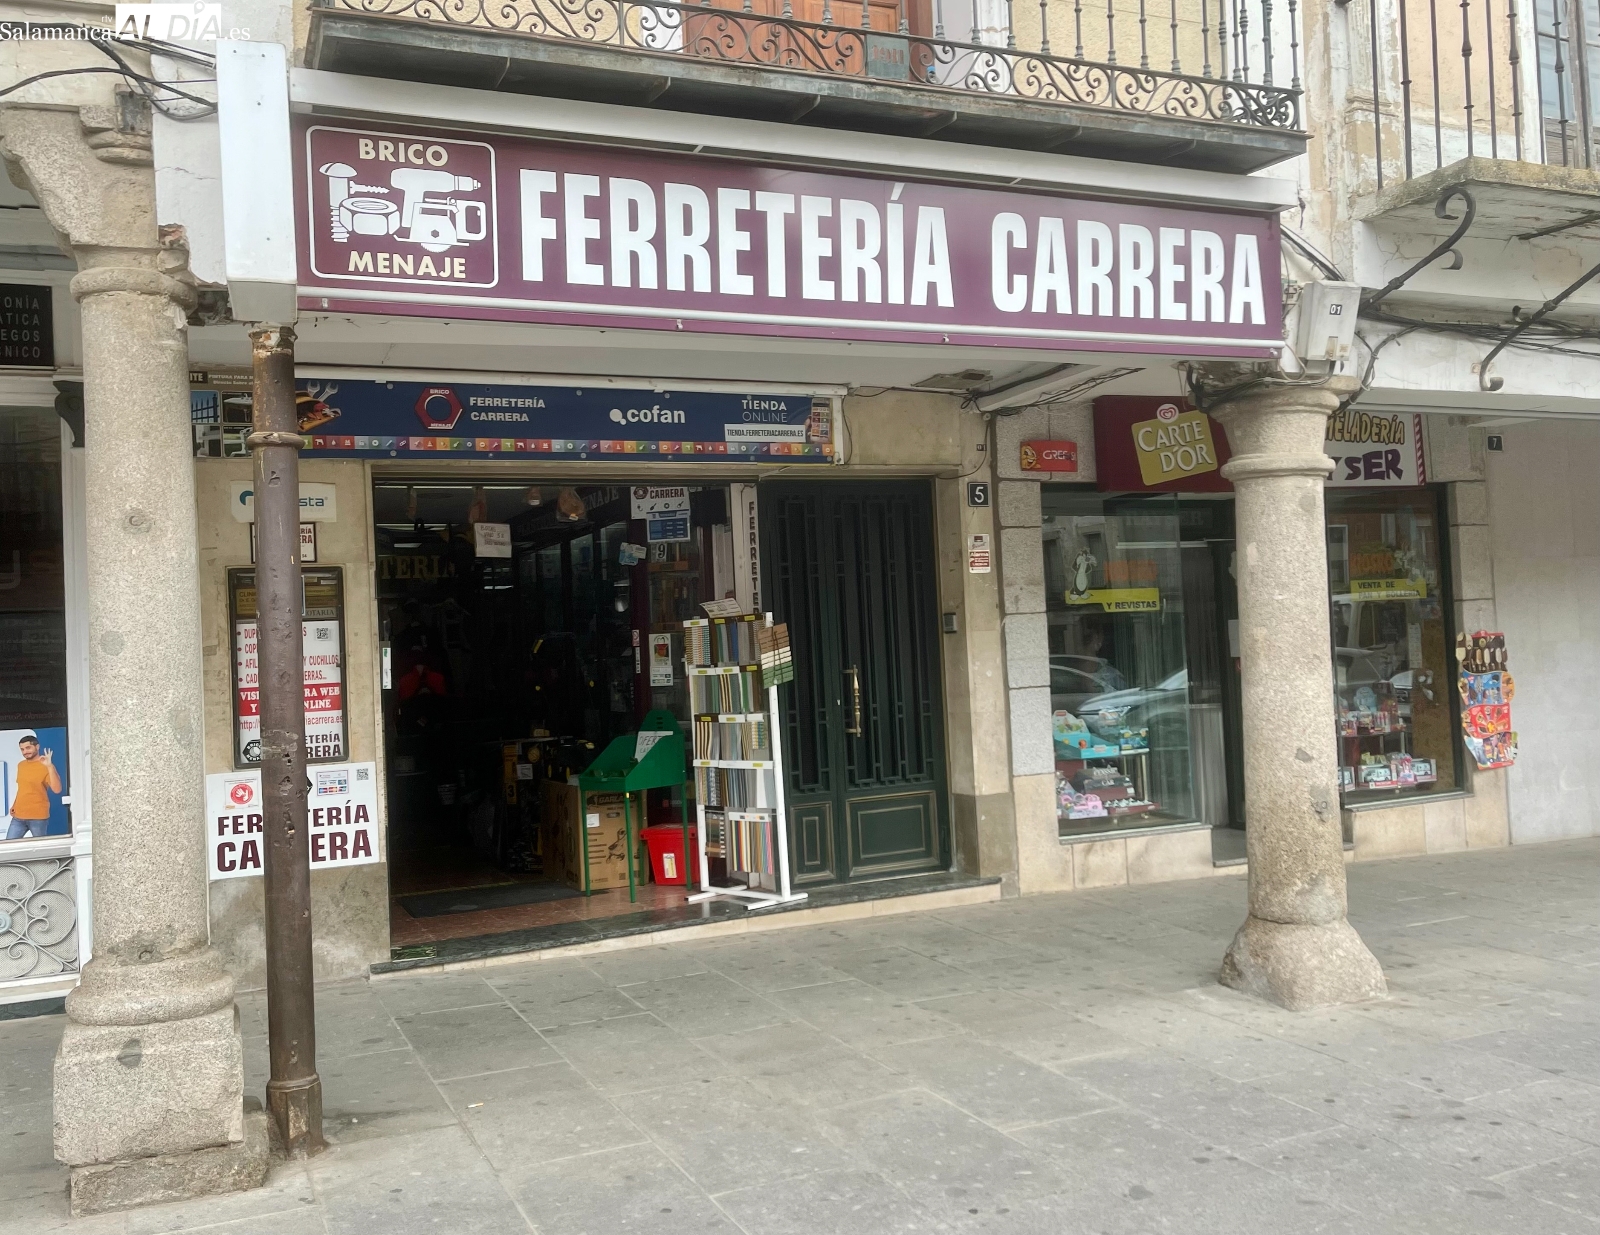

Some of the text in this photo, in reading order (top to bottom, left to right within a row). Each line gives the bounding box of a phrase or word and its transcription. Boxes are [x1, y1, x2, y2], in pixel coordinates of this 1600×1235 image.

[358, 138, 448, 167] BRICO
[520, 169, 1267, 325] FERRETERÍA CARRERA
[348, 250, 467, 279] MENAJE
[3, 294, 40, 310] ONÍA
[0, 328, 40, 342] EGOS
[0, 345, 40, 359] NICO
[469, 397, 546, 409] FERRETERÍA
[741, 399, 788, 411] TIENDA
[470, 411, 530, 422] CARRERA
[627, 404, 686, 424] cofan
[742, 411, 788, 423] ONLINE
[1138, 420, 1205, 452] CARTE
[1492, 438, 1498, 449] 7
[649, 488, 685, 500] CARRERA
[974, 486, 985, 503] 5
[1106, 601, 1157, 610] Y REVISTAS
[304, 609, 335, 617] OTARIA
[309, 654, 339, 666] CUCHILLOS
[320, 686, 340, 697] WEB
[303, 699, 332, 710] NLINE
